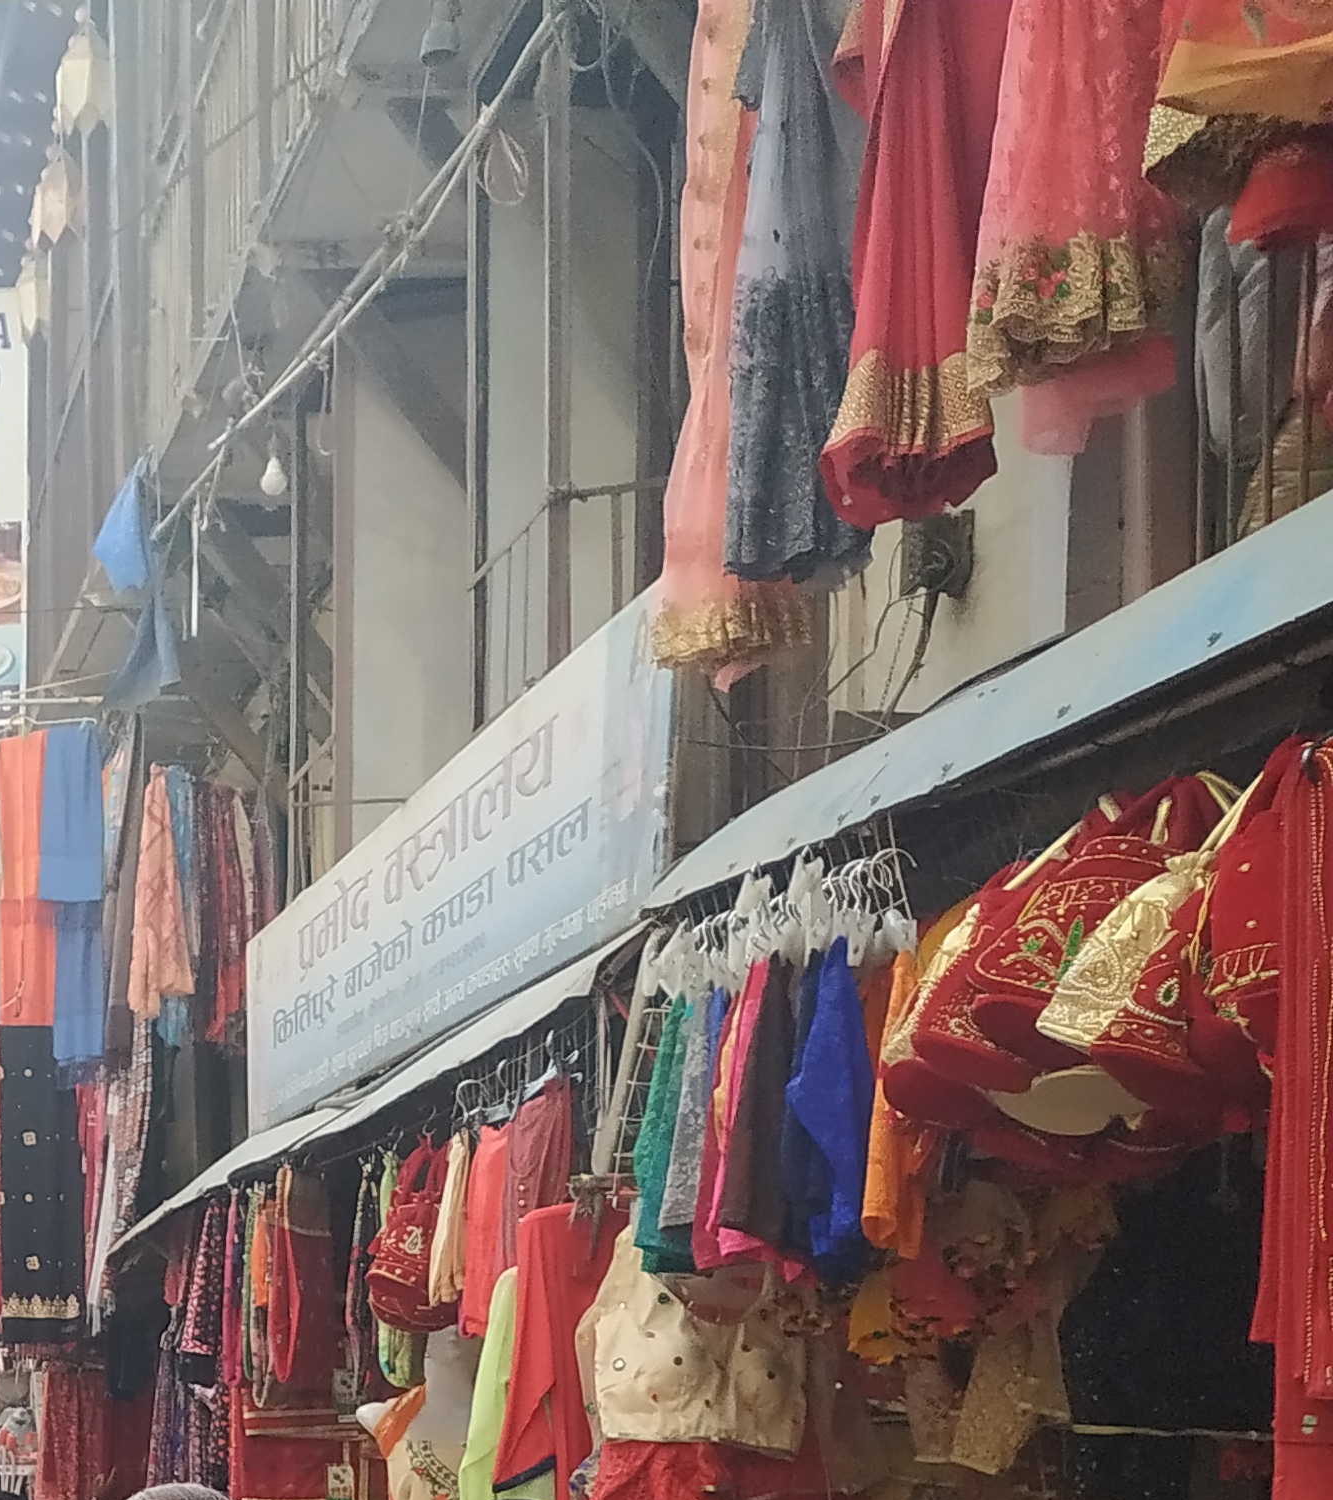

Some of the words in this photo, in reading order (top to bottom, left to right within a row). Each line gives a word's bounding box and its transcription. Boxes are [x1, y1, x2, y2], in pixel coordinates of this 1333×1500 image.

[297, 868, 373, 982] प्रमोद
[383, 712, 560, 905] वस्त्रालय
[344, 920, 413, 999] बाजेको
[421, 866, 494, 946] कपडा
[505, 797, 593, 889] पसल
